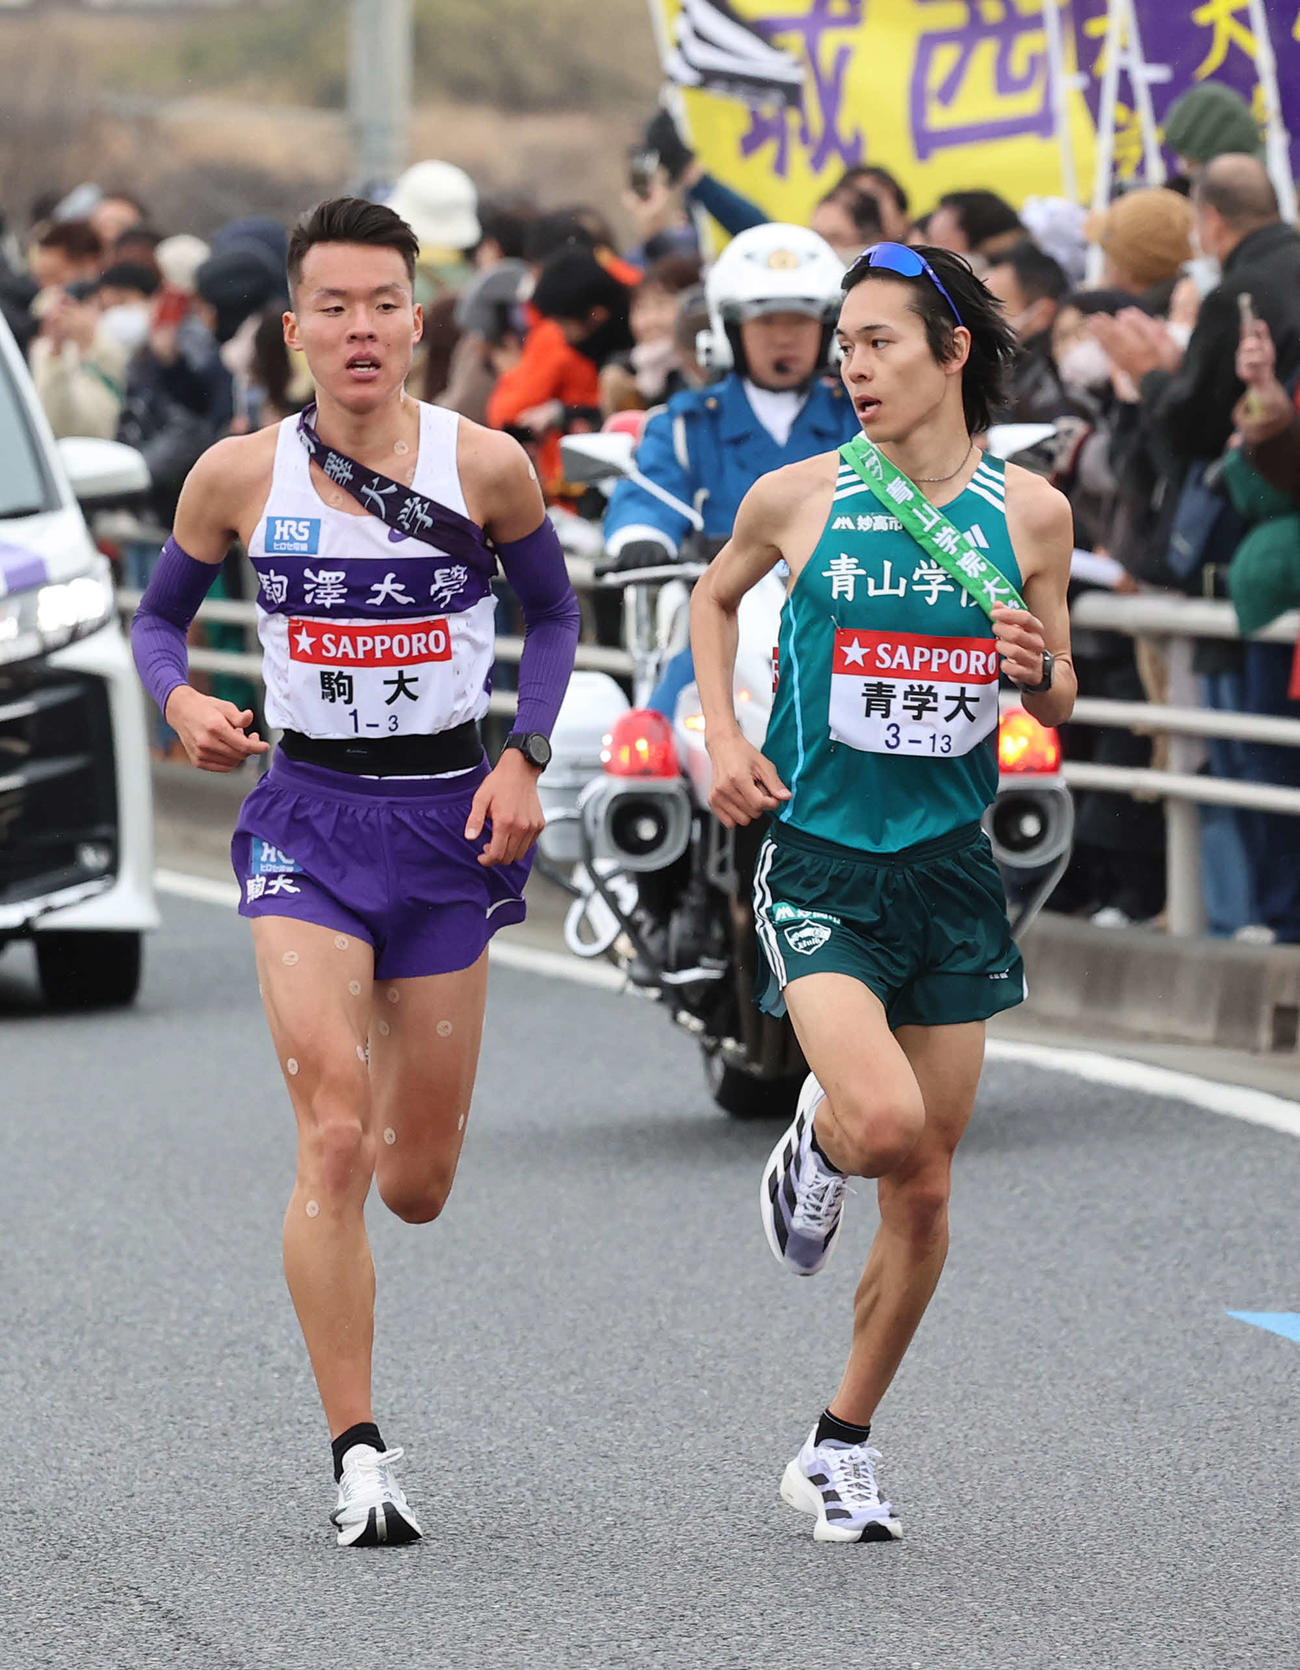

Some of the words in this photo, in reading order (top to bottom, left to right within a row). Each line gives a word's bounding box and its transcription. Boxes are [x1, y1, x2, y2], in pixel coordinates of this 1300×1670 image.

[273, 519, 311, 541] HRS
[321, 629, 447, 660] SAPPORO
[861, 681, 981, 724] 青学大
